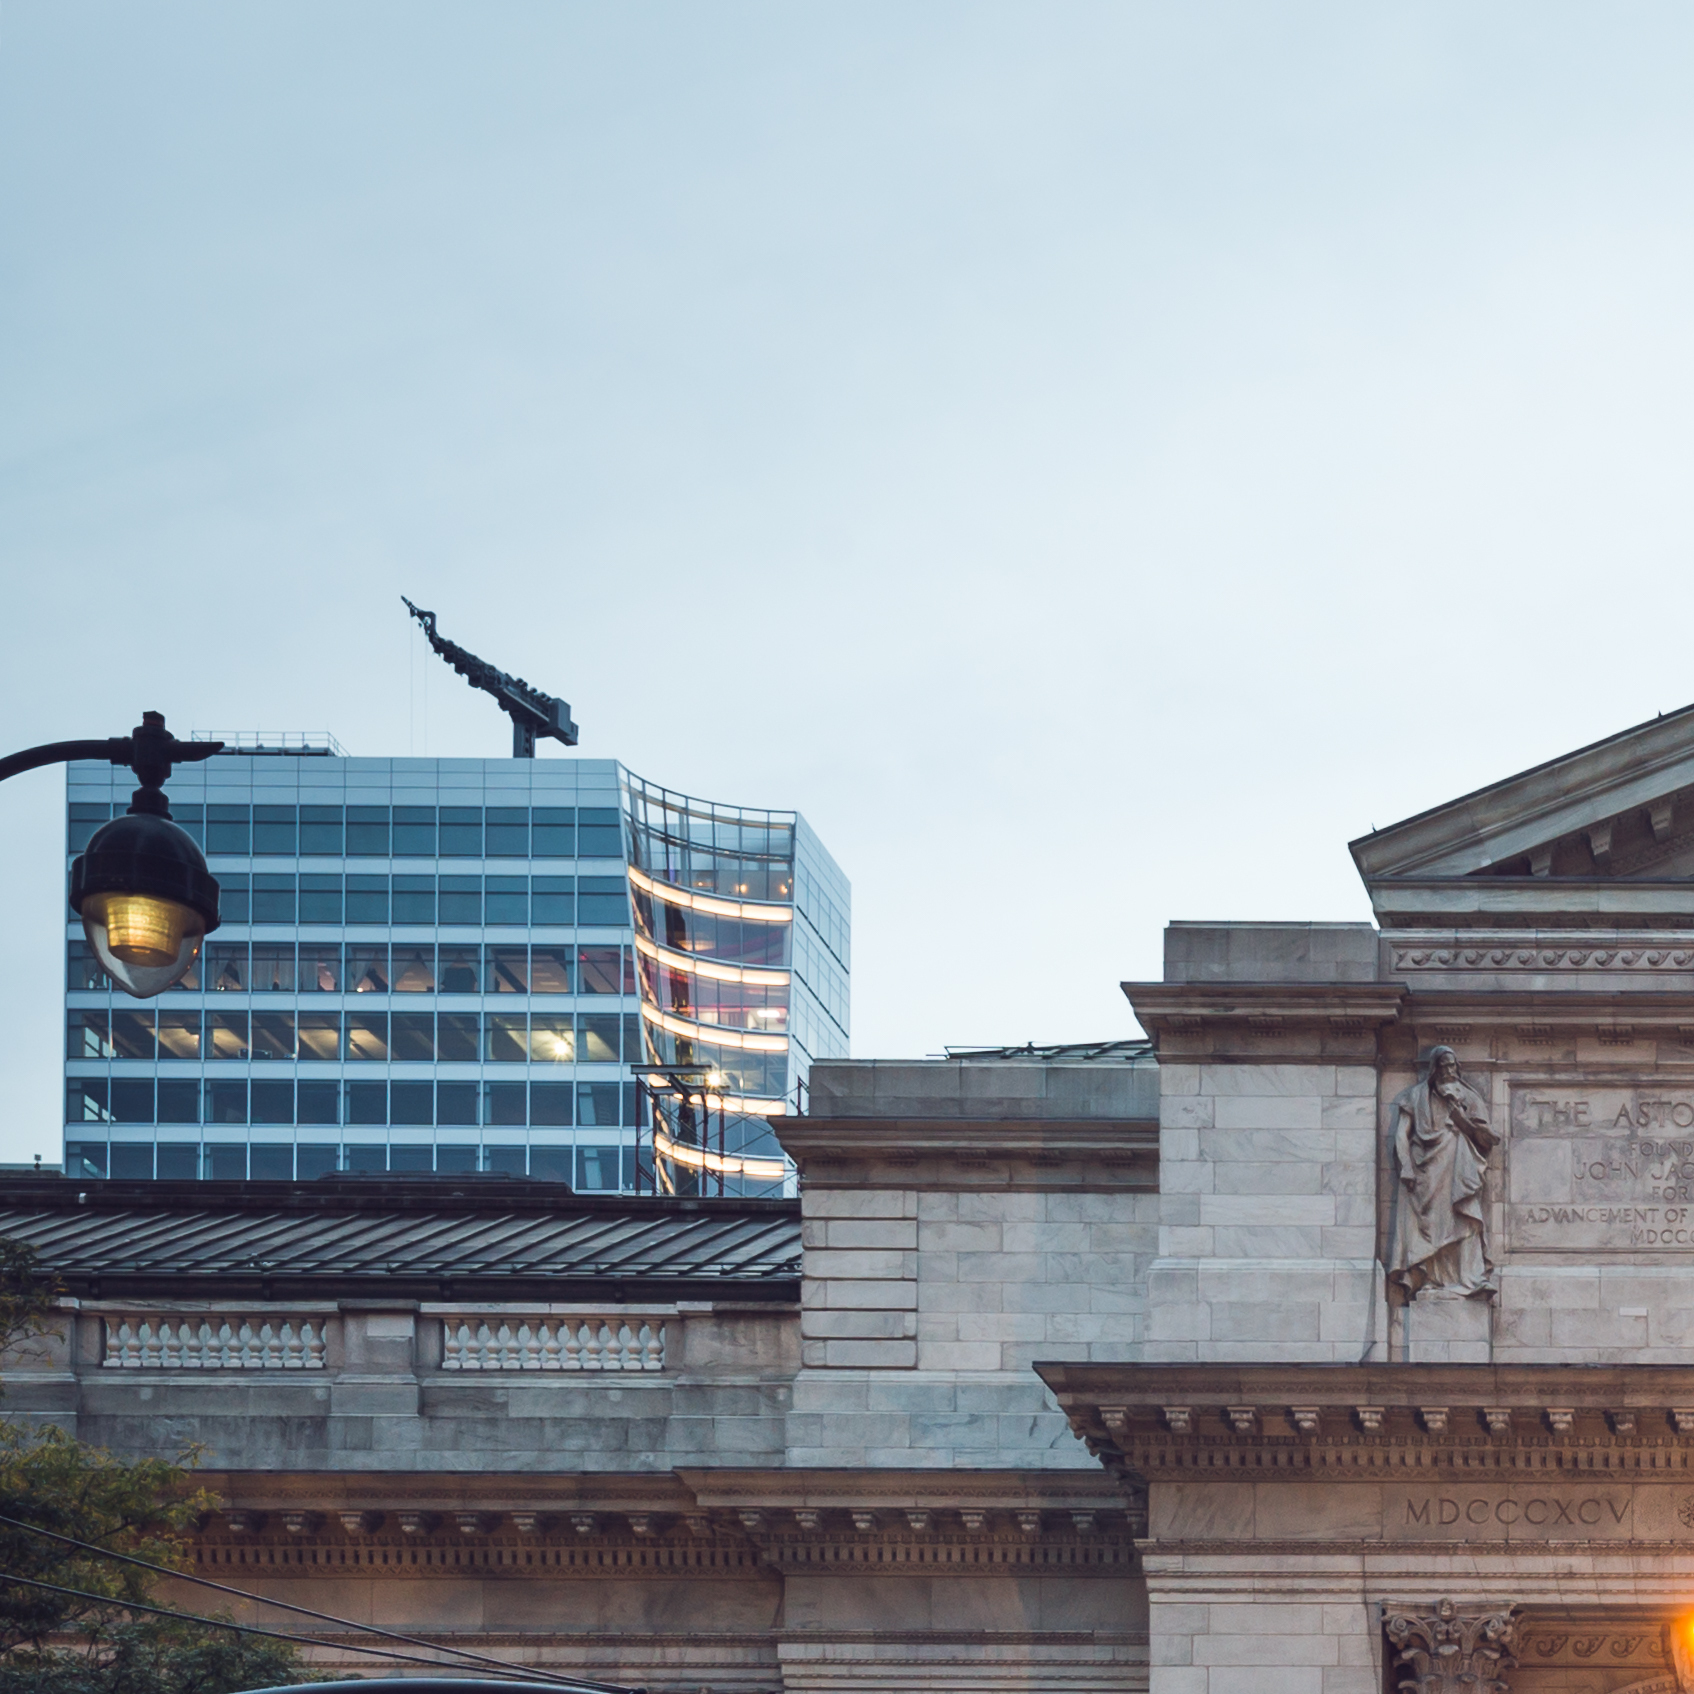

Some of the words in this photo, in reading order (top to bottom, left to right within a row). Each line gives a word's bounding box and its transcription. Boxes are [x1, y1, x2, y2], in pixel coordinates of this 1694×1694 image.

[1532, 1101, 1592, 1128] THE
[1574, 1162, 1639, 1181] JOHN
[1651, 1186, 1689, 1202] FOR
[1526, 1208, 1659, 1224] ADVANCEMENT
[1664, 1208, 1689, 1223] OF
[1404, 1499, 1632, 1525] MDCCCXCV
